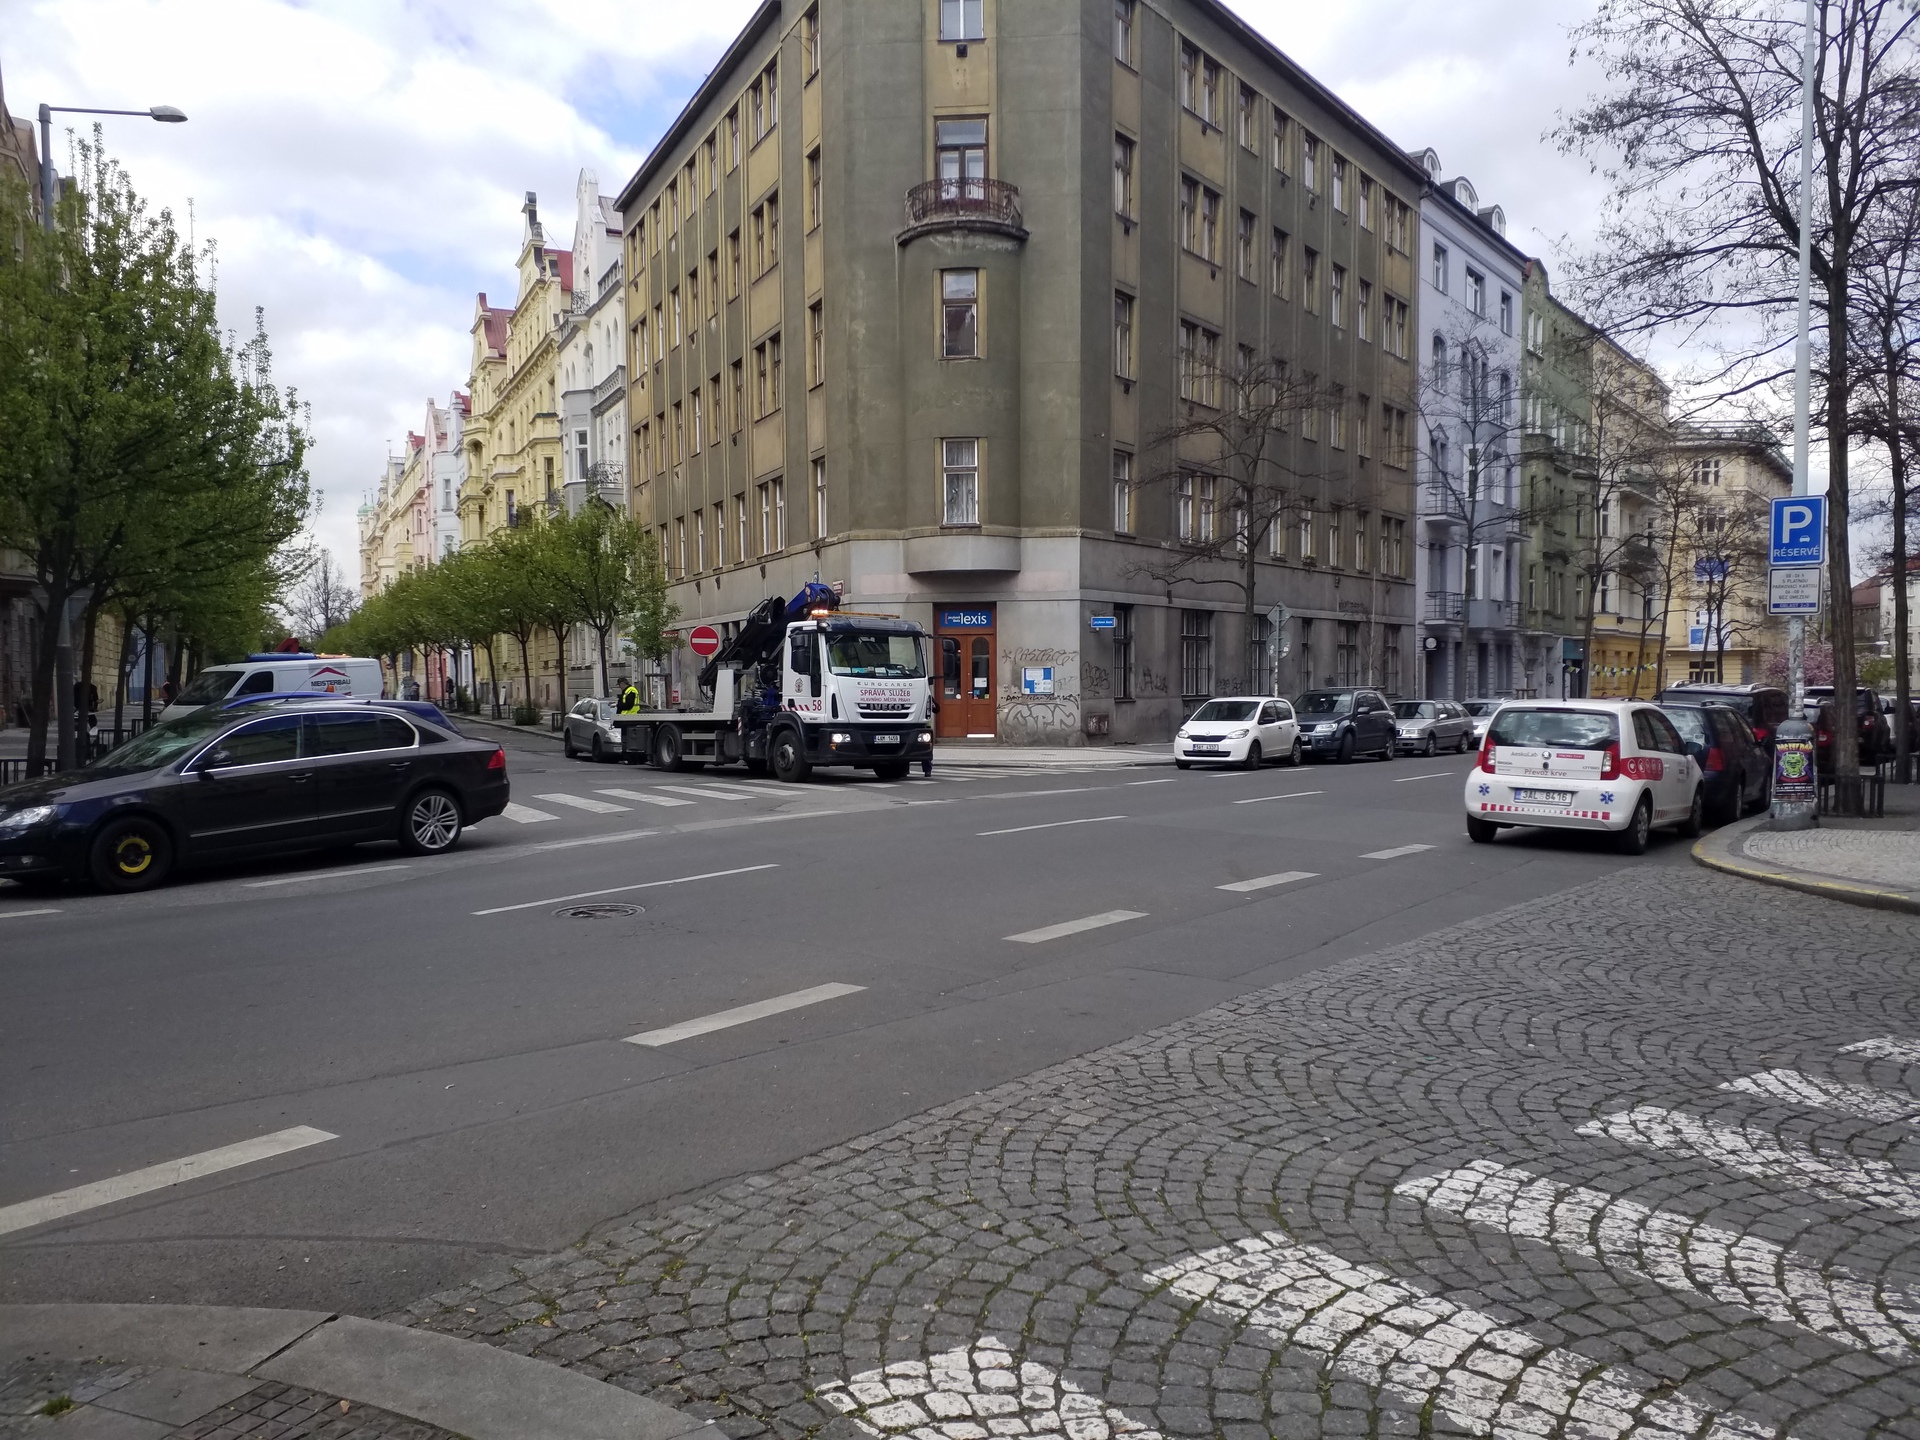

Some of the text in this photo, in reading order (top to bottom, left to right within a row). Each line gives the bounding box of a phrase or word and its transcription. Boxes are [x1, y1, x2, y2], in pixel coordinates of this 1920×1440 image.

[1782, 505, 1812, 543] P
[1773, 545, 1819, 557] RÉSERVÉ
[960, 613, 987, 624] lexis
[311, 679, 351, 687] MEISTERBAU
[860, 688, 911, 697] SPRÁVA SLUŽEB
[813, 700, 822, 711] 58
[870, 703, 902, 711] IVECO
[1525, 768, 1567, 777] Převoz krve
[1523, 790, 1567, 801] 3AL 8416
